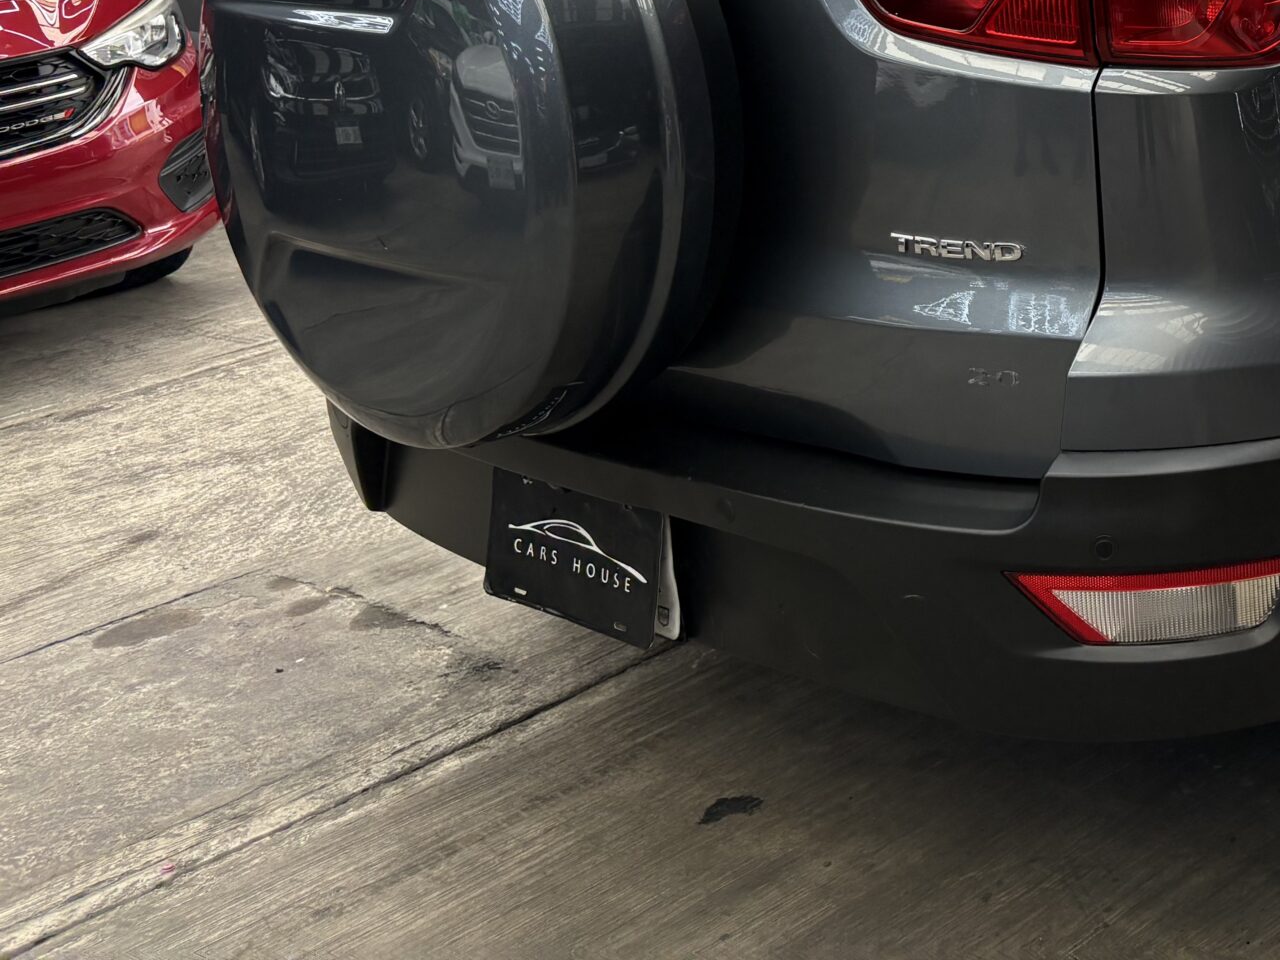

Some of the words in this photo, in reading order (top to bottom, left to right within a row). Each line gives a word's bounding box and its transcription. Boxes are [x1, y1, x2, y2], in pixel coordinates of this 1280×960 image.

[890, 232, 1022, 261] TREND
[513, 538, 558, 565] CARS
[572, 557, 631, 593] HOUSE
